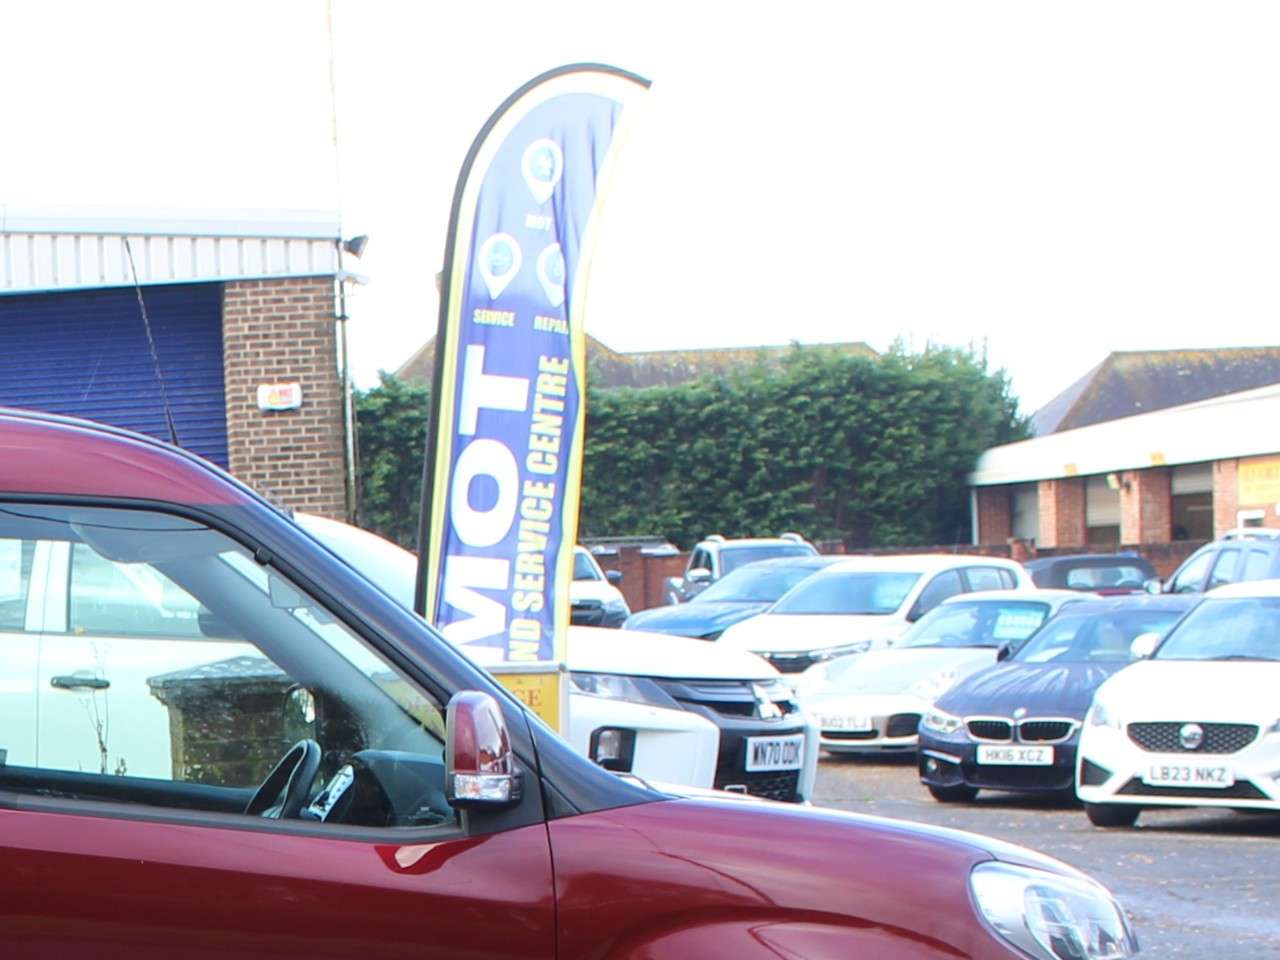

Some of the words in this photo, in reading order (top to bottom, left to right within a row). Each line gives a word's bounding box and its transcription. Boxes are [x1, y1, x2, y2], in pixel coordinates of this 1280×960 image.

[473, 308, 516, 327] SERVICE
[525, 355, 570, 476] CENTRE
[442, 344, 530, 666] MOT
[511, 480, 556, 613] SERVICE
[985, 749, 1015, 762] HK16
[1150, 766, 1191, 781] LB23
[1195, 766, 1227, 782] NKZ
